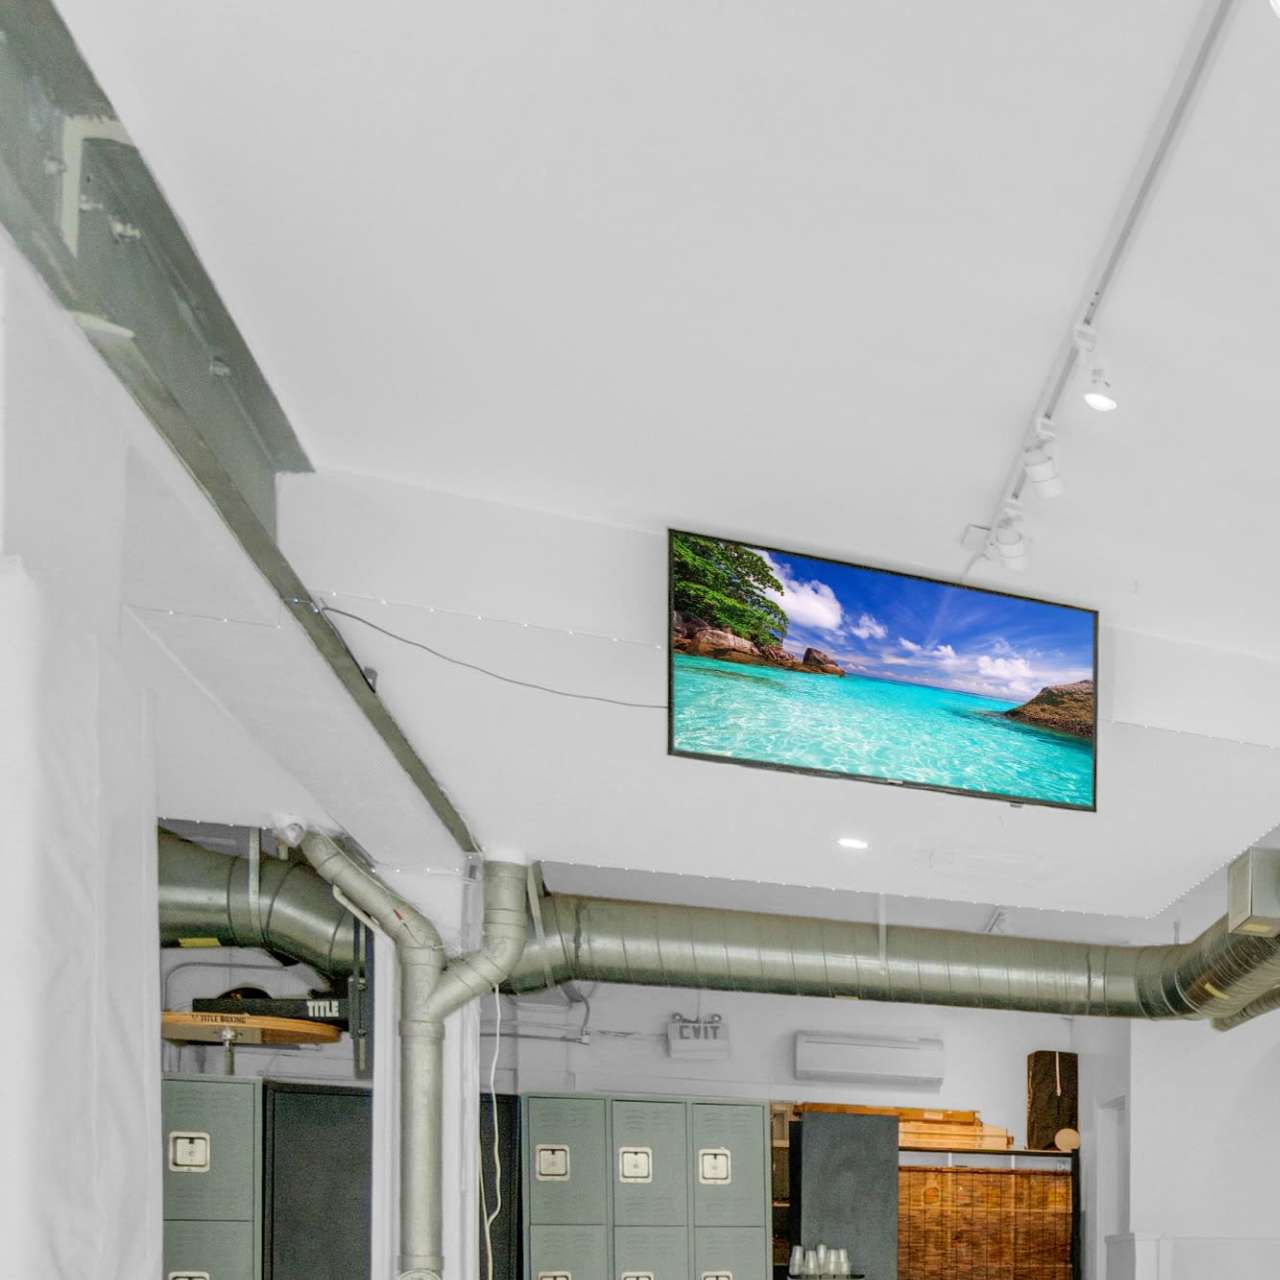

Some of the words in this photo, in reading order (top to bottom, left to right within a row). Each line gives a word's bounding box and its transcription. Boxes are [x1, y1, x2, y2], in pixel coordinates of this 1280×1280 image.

[306, 1000, 339, 1018] TITLE
[199, 1014, 219, 1023] TITLE
[220, 1014, 247, 1024] BOXING
[679, 1025, 720, 1040] EXIT
